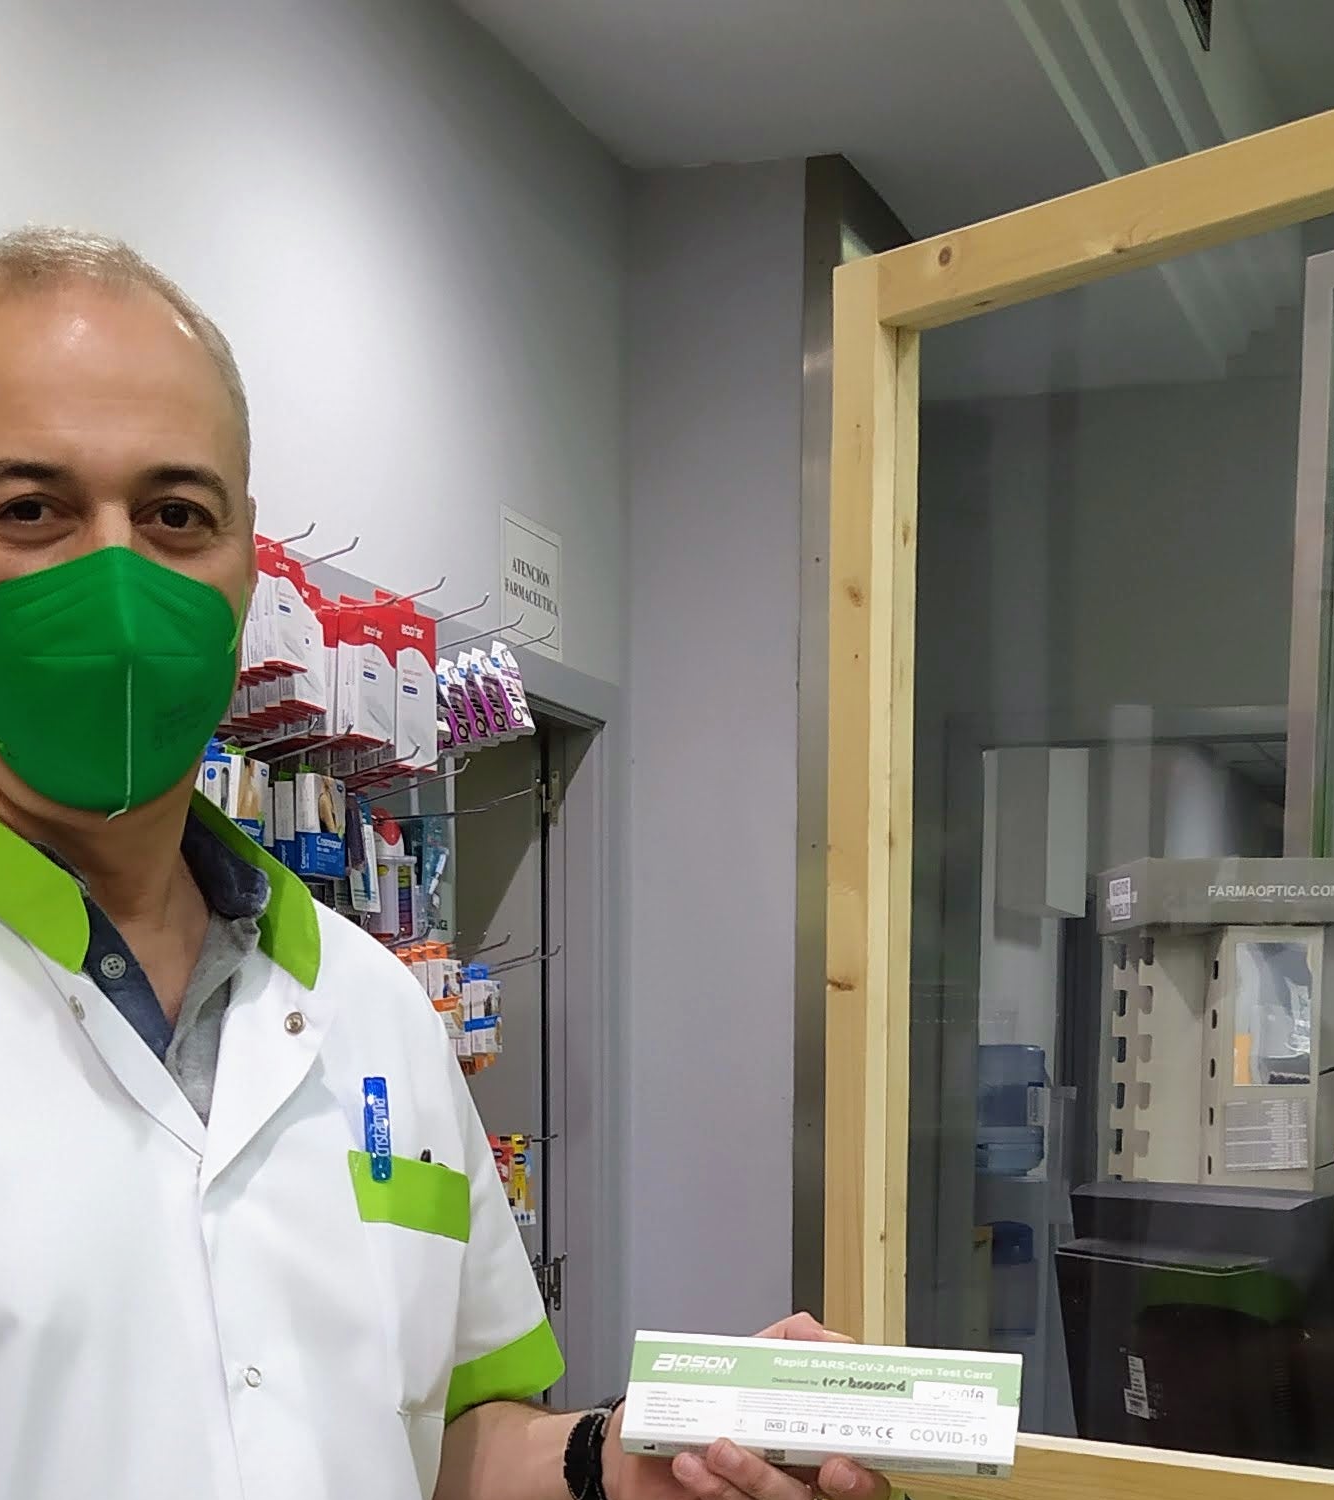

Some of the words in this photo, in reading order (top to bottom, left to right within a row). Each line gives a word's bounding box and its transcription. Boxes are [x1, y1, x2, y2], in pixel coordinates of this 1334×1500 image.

[512, 556, 551, 588] ATENCIÓN
[652, 1352, 737, 1371] BOSON
[773, 1356, 808, 1369] Rapid
[810, 1359, 884, 1373] SARS-CoV-2
[886, 1364, 933, 1377] Antigen
[937, 1367, 961, 1378] Test
[963, 1369, 993, 1380] Card
[909, 1428, 988, 1446] COVID-19
